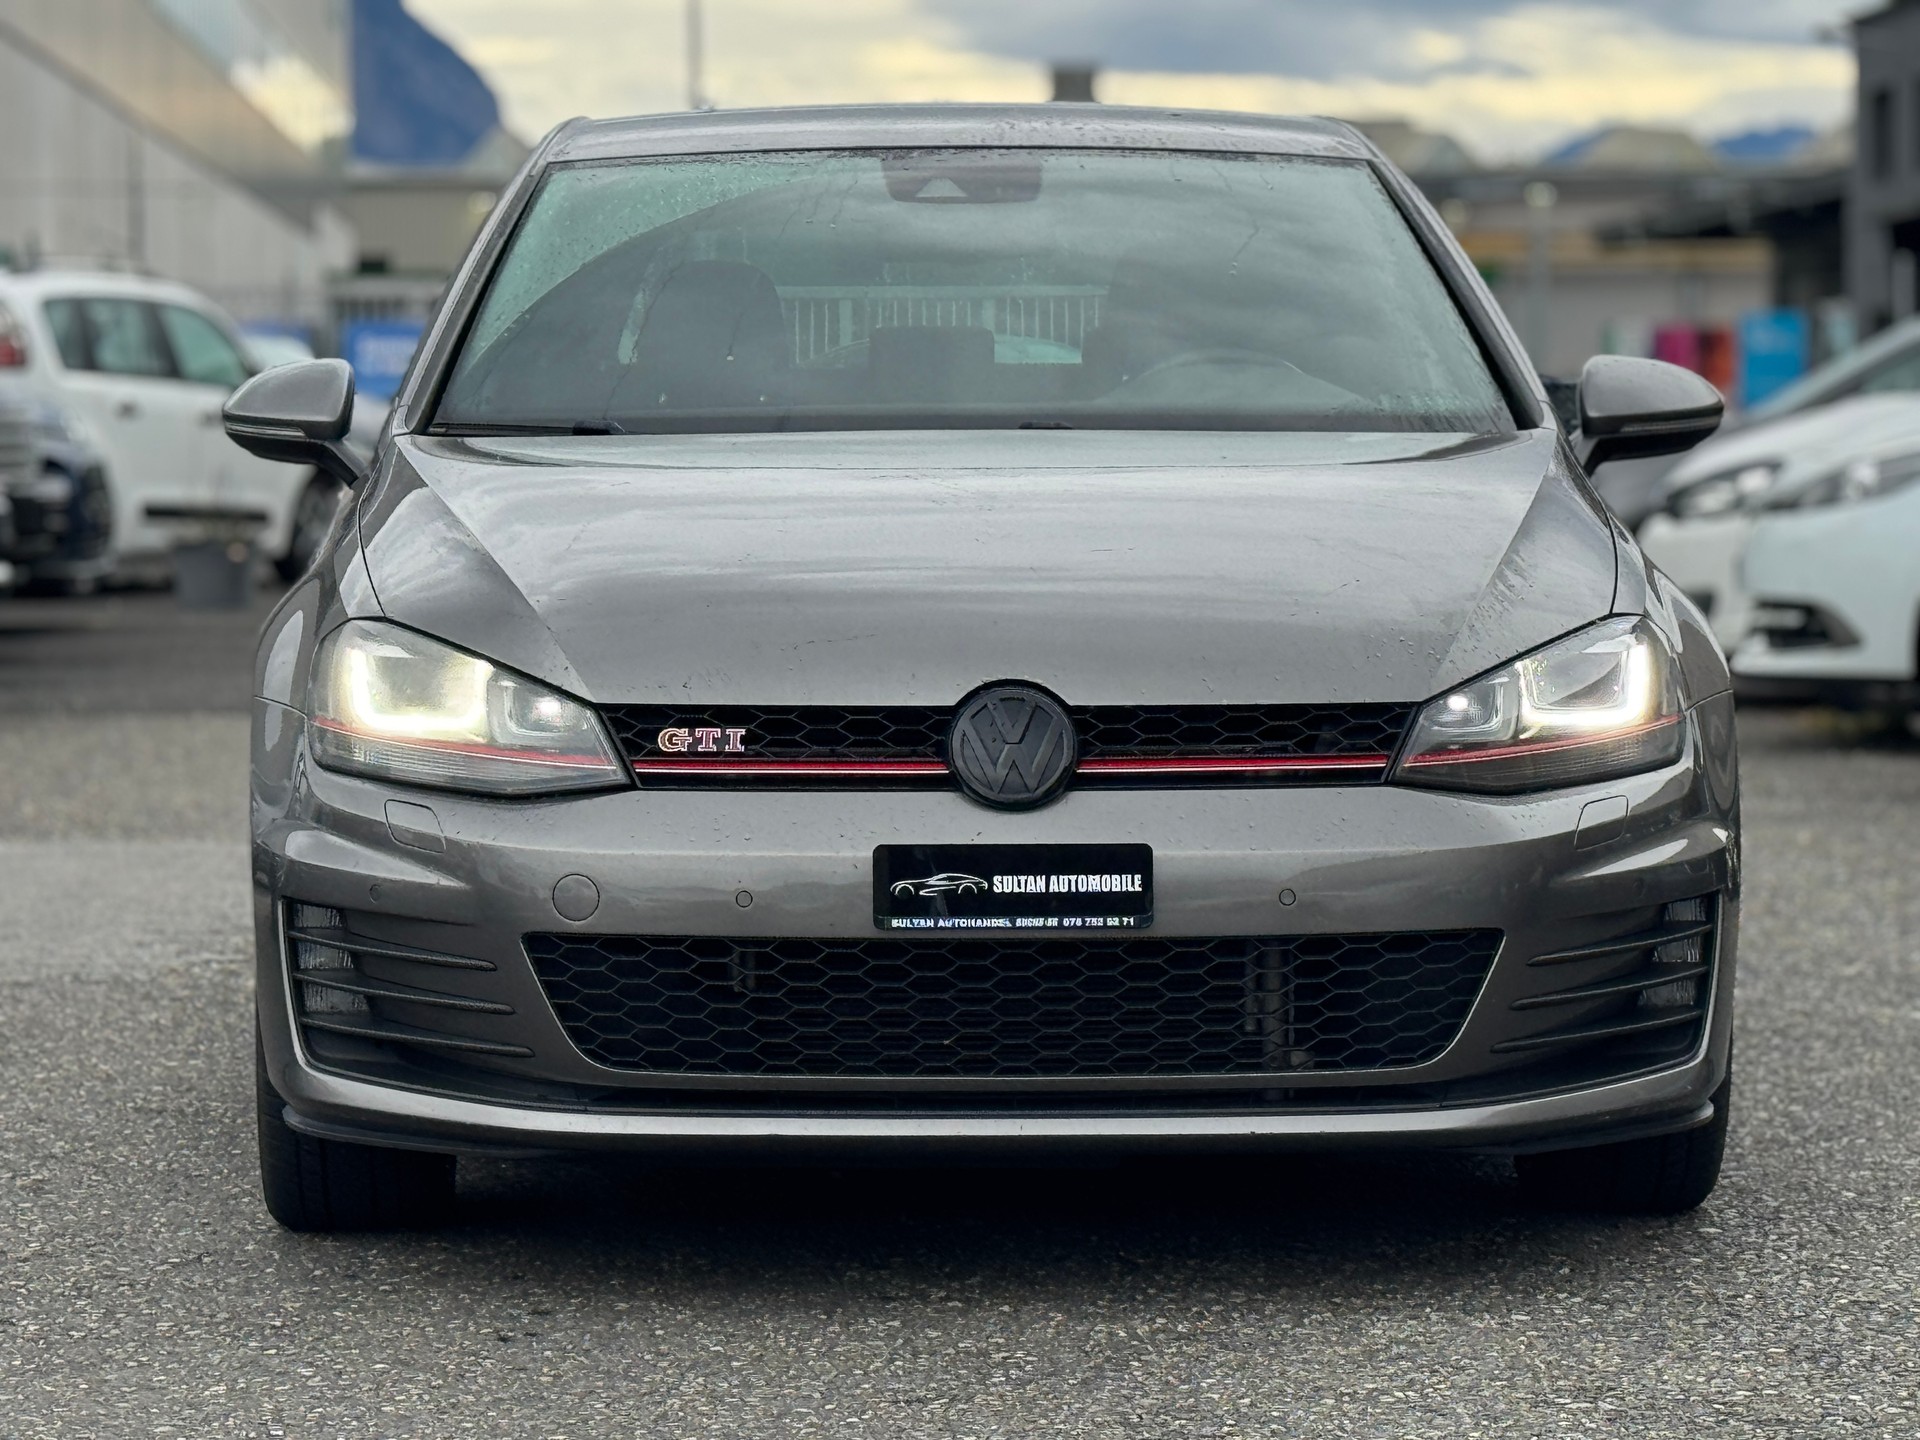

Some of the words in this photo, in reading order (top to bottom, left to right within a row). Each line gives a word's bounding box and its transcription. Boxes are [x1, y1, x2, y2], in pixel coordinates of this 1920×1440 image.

[657, 727, 746, 752] GTI
[957, 692, 1070, 799] VW
[992, 875, 1046, 893] SULTAN
[1048, 874, 1143, 893] AUTOMOBILE
